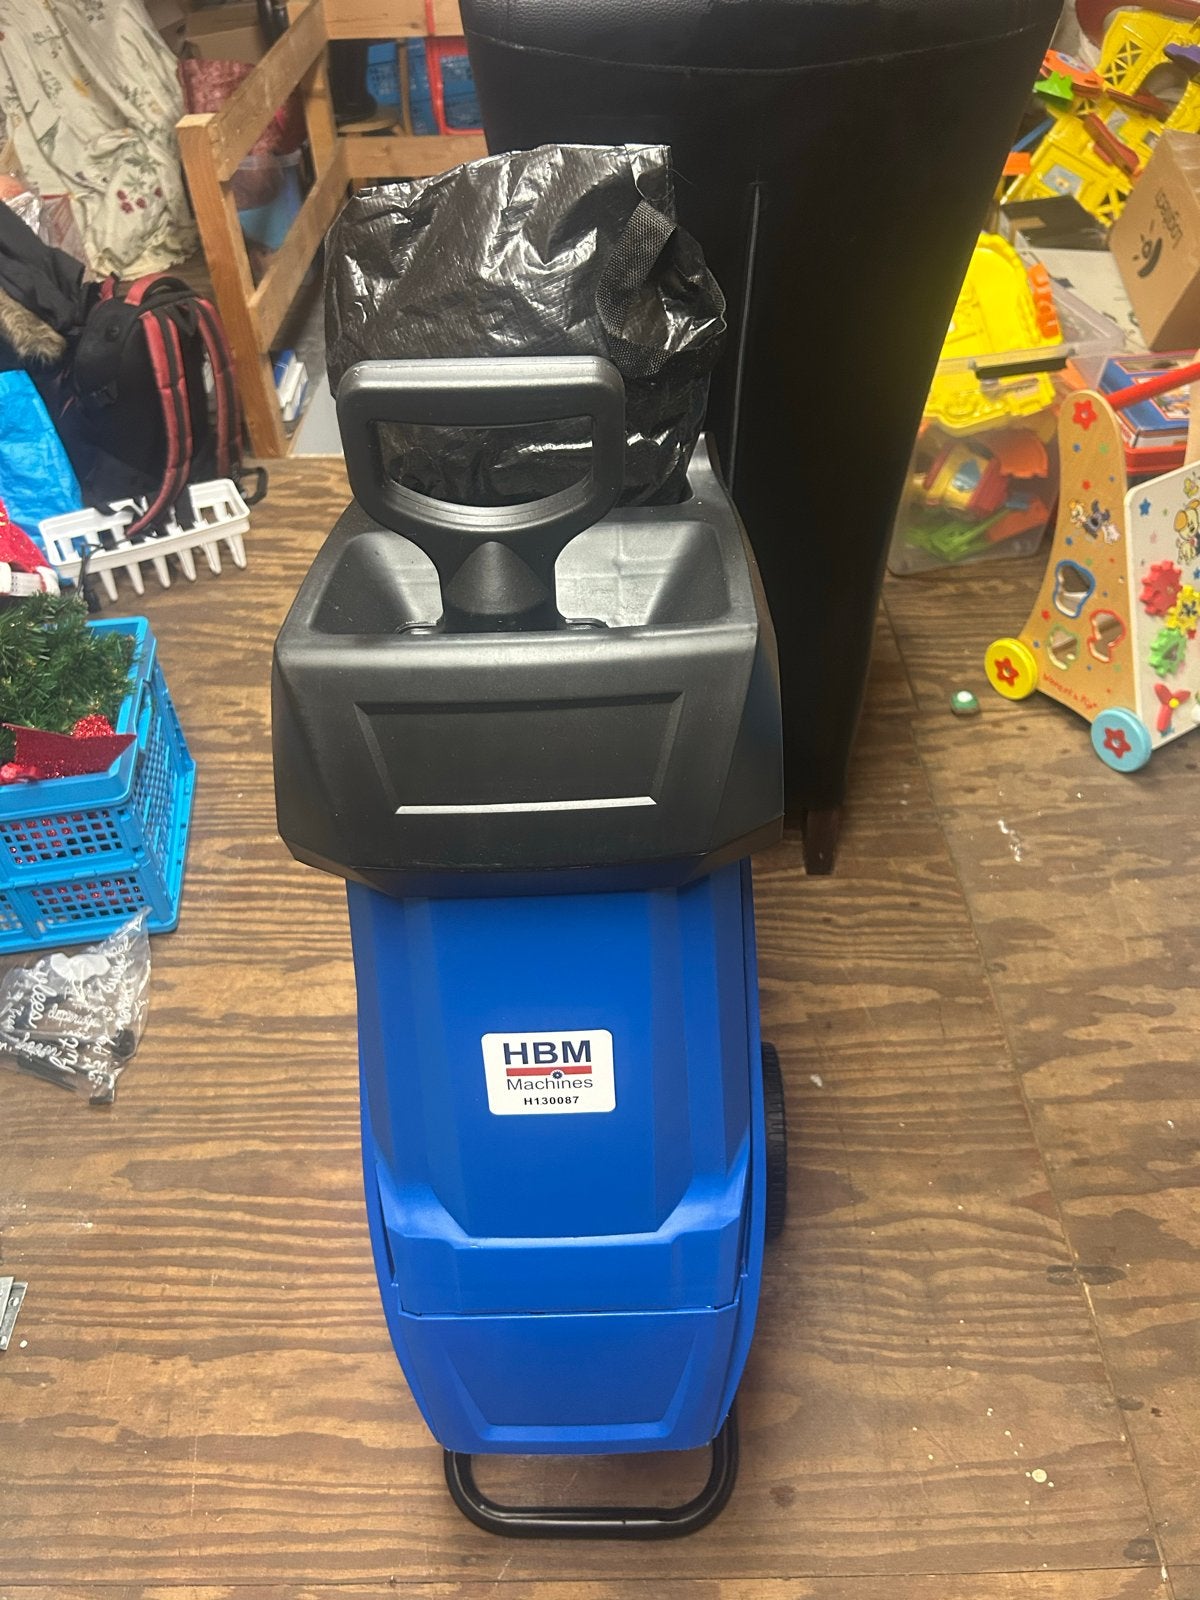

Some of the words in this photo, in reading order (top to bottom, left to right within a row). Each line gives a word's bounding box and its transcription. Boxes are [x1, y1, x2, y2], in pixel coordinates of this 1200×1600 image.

[503, 1040, 592, 1065] HBM
[507, 1078, 593, 1091] Machines
[523, 1096, 580, 1106] H130087
